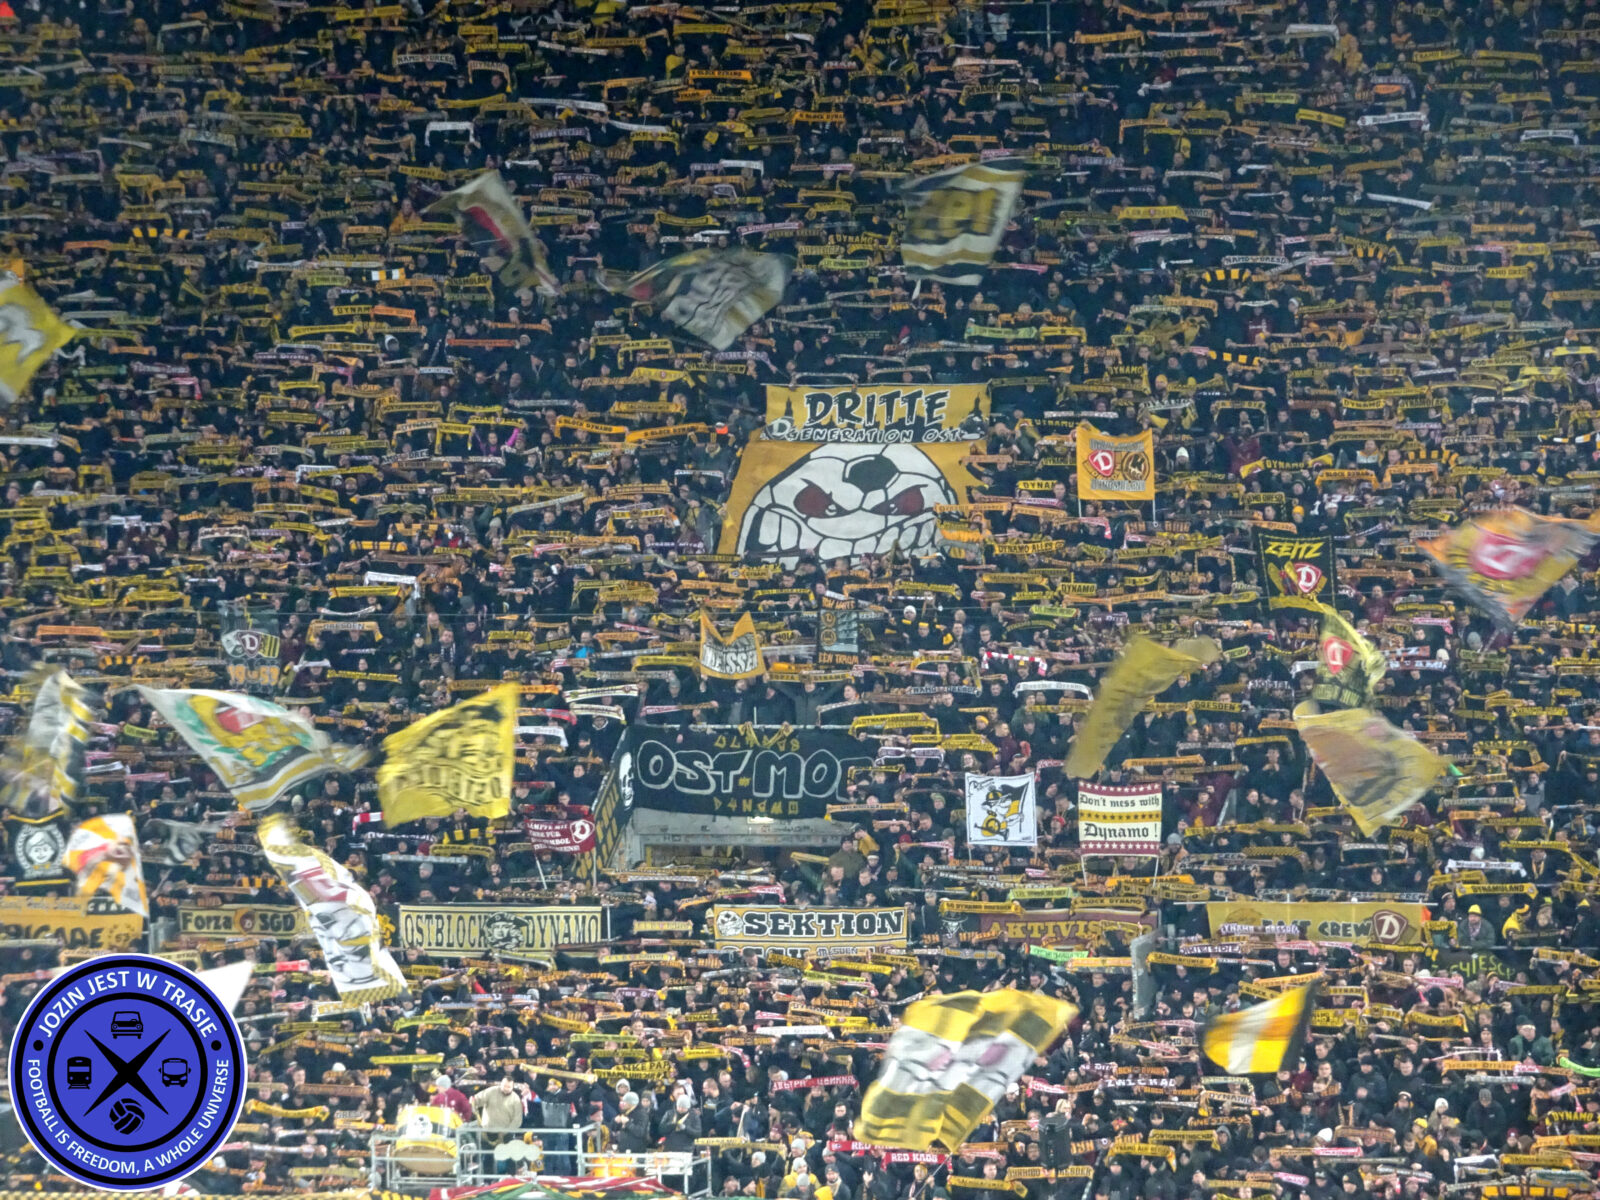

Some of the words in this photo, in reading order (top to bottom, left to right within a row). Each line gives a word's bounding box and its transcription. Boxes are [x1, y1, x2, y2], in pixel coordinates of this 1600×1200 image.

[805, 389, 950, 427] DRITTE
[786, 427, 914, 443] GENERATION
[1022, 481, 1053, 490] DYNAM
[998, 544, 1031, 554] DYNAMO
[1265, 541, 1325, 559] ZEITZ
[1061, 583, 1096, 594] DYNAMO
[322, 621, 365, 632] DRESDEN
[1194, 701, 1237, 711] DRESDEN
[1079, 793, 1107, 807] Don't
[1109, 797, 1136, 808] mess
[1138, 795, 1160, 807] with
[1083, 822, 1150, 841] Dynamo
[181, 912, 233, 931] Forza
[259, 913, 296, 932] SGD
[742, 909, 904, 937] SEKTION
[1318, 920, 1374, 938] CREW
[404, 914, 488, 948] OSTBLOCK
[525, 914, 600, 947] DYNAMO
[1553, 1110, 1595, 1122] DYNAMO
[891, 1152, 910, 1162] RED
